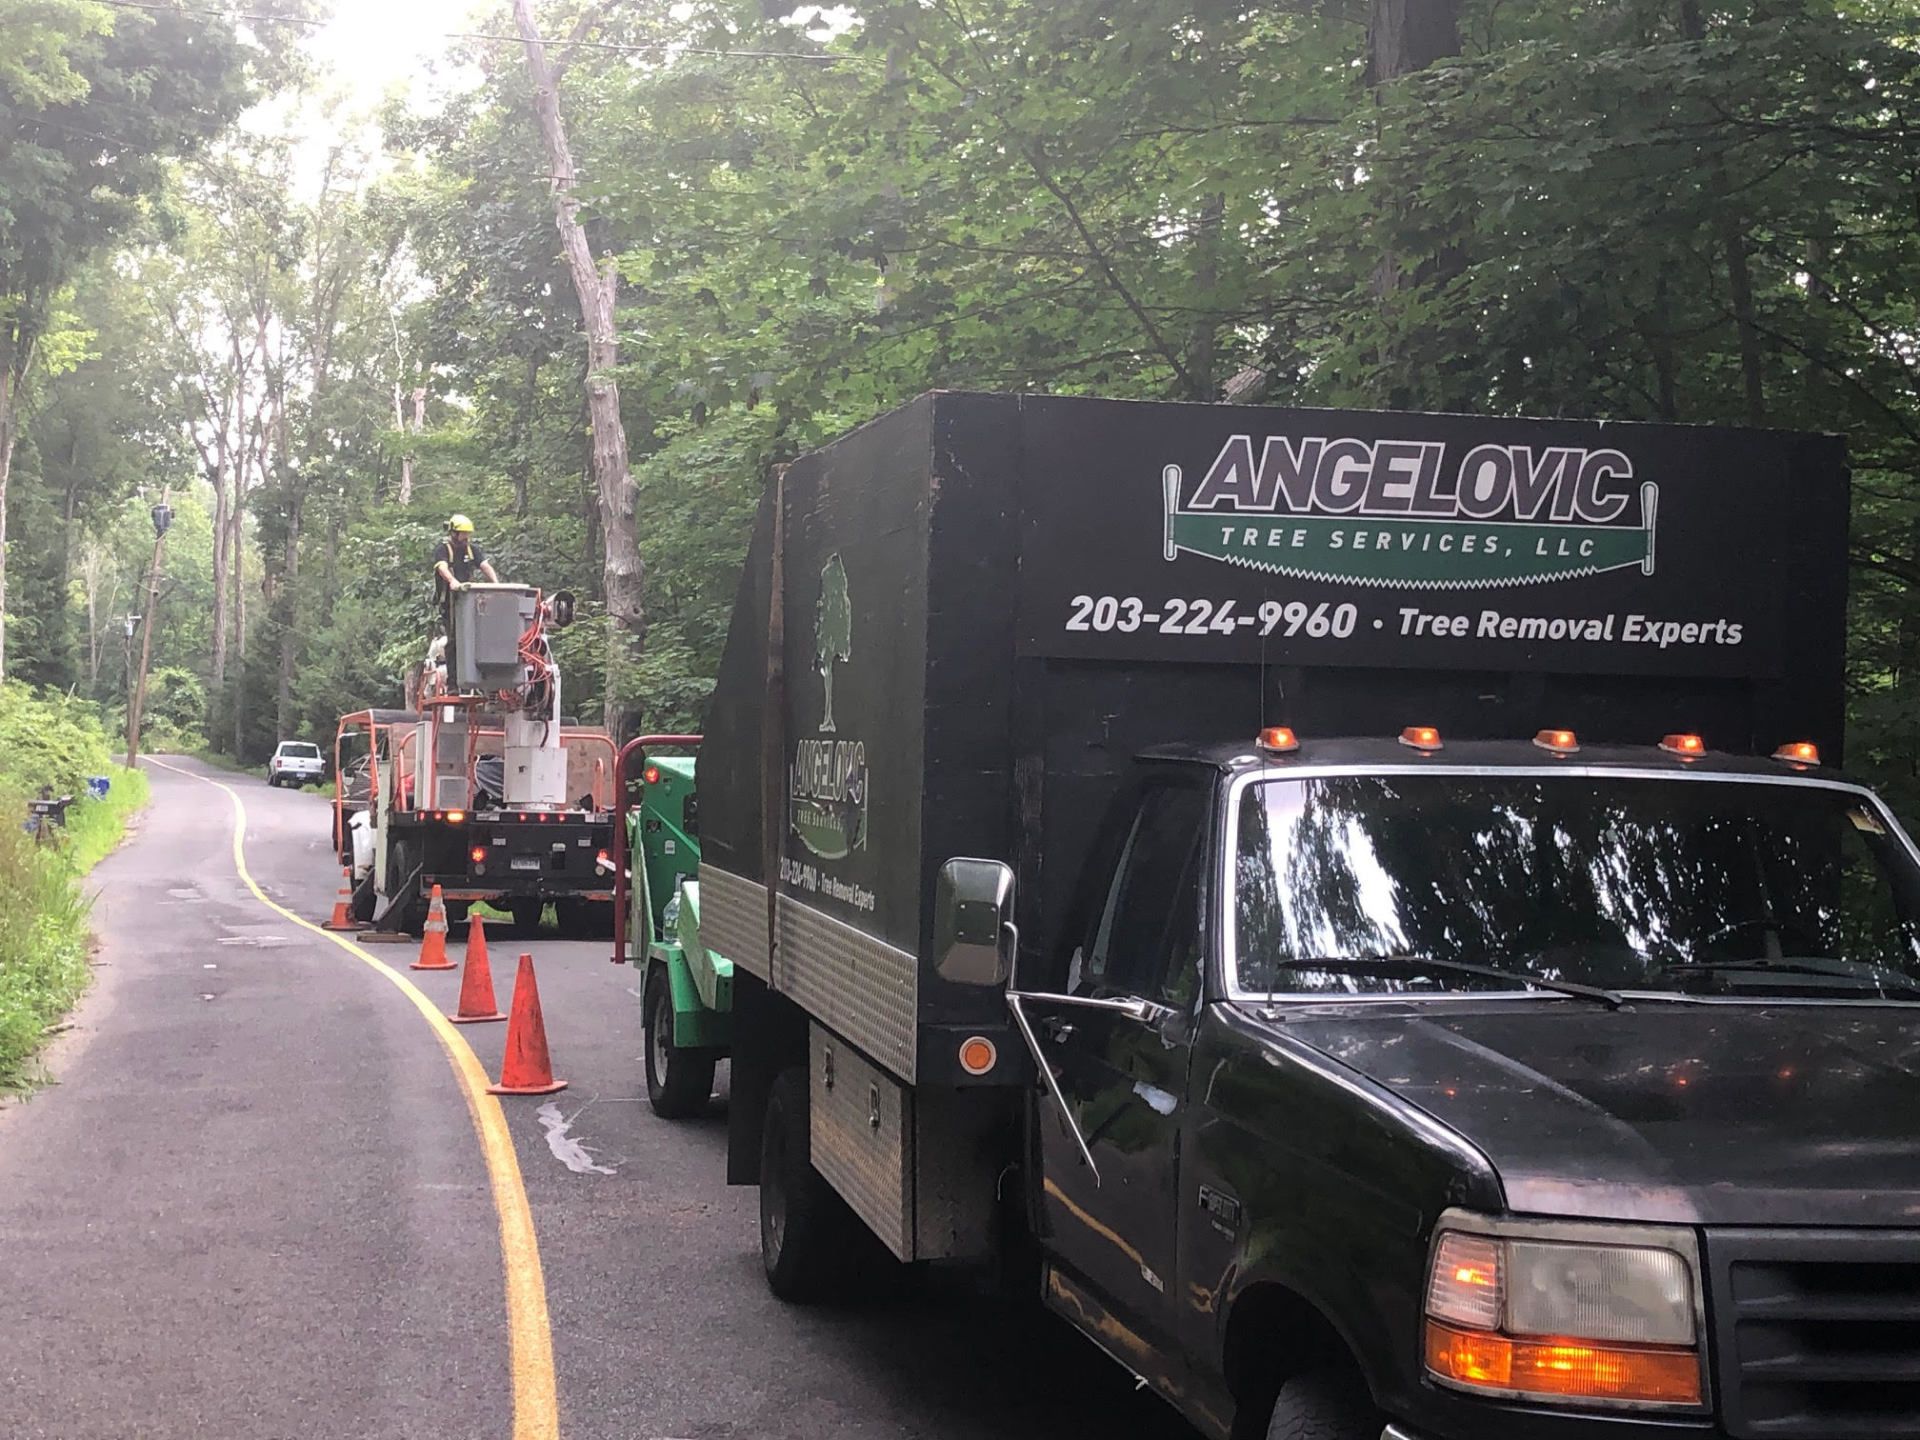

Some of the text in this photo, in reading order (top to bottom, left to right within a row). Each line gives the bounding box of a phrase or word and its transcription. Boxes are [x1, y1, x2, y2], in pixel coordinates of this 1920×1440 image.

[1187, 434, 1633, 523] ANGELOVIC
[1221, 527, 1594, 557] TREE SERVICES, LLC
[1065, 595, 1743, 648] 203-224-9960 Tree Removal Experts
[821, 872, 834, 896] Tree
[833, 876, 855, 904] Removal
[854, 884, 875, 912] Experts
